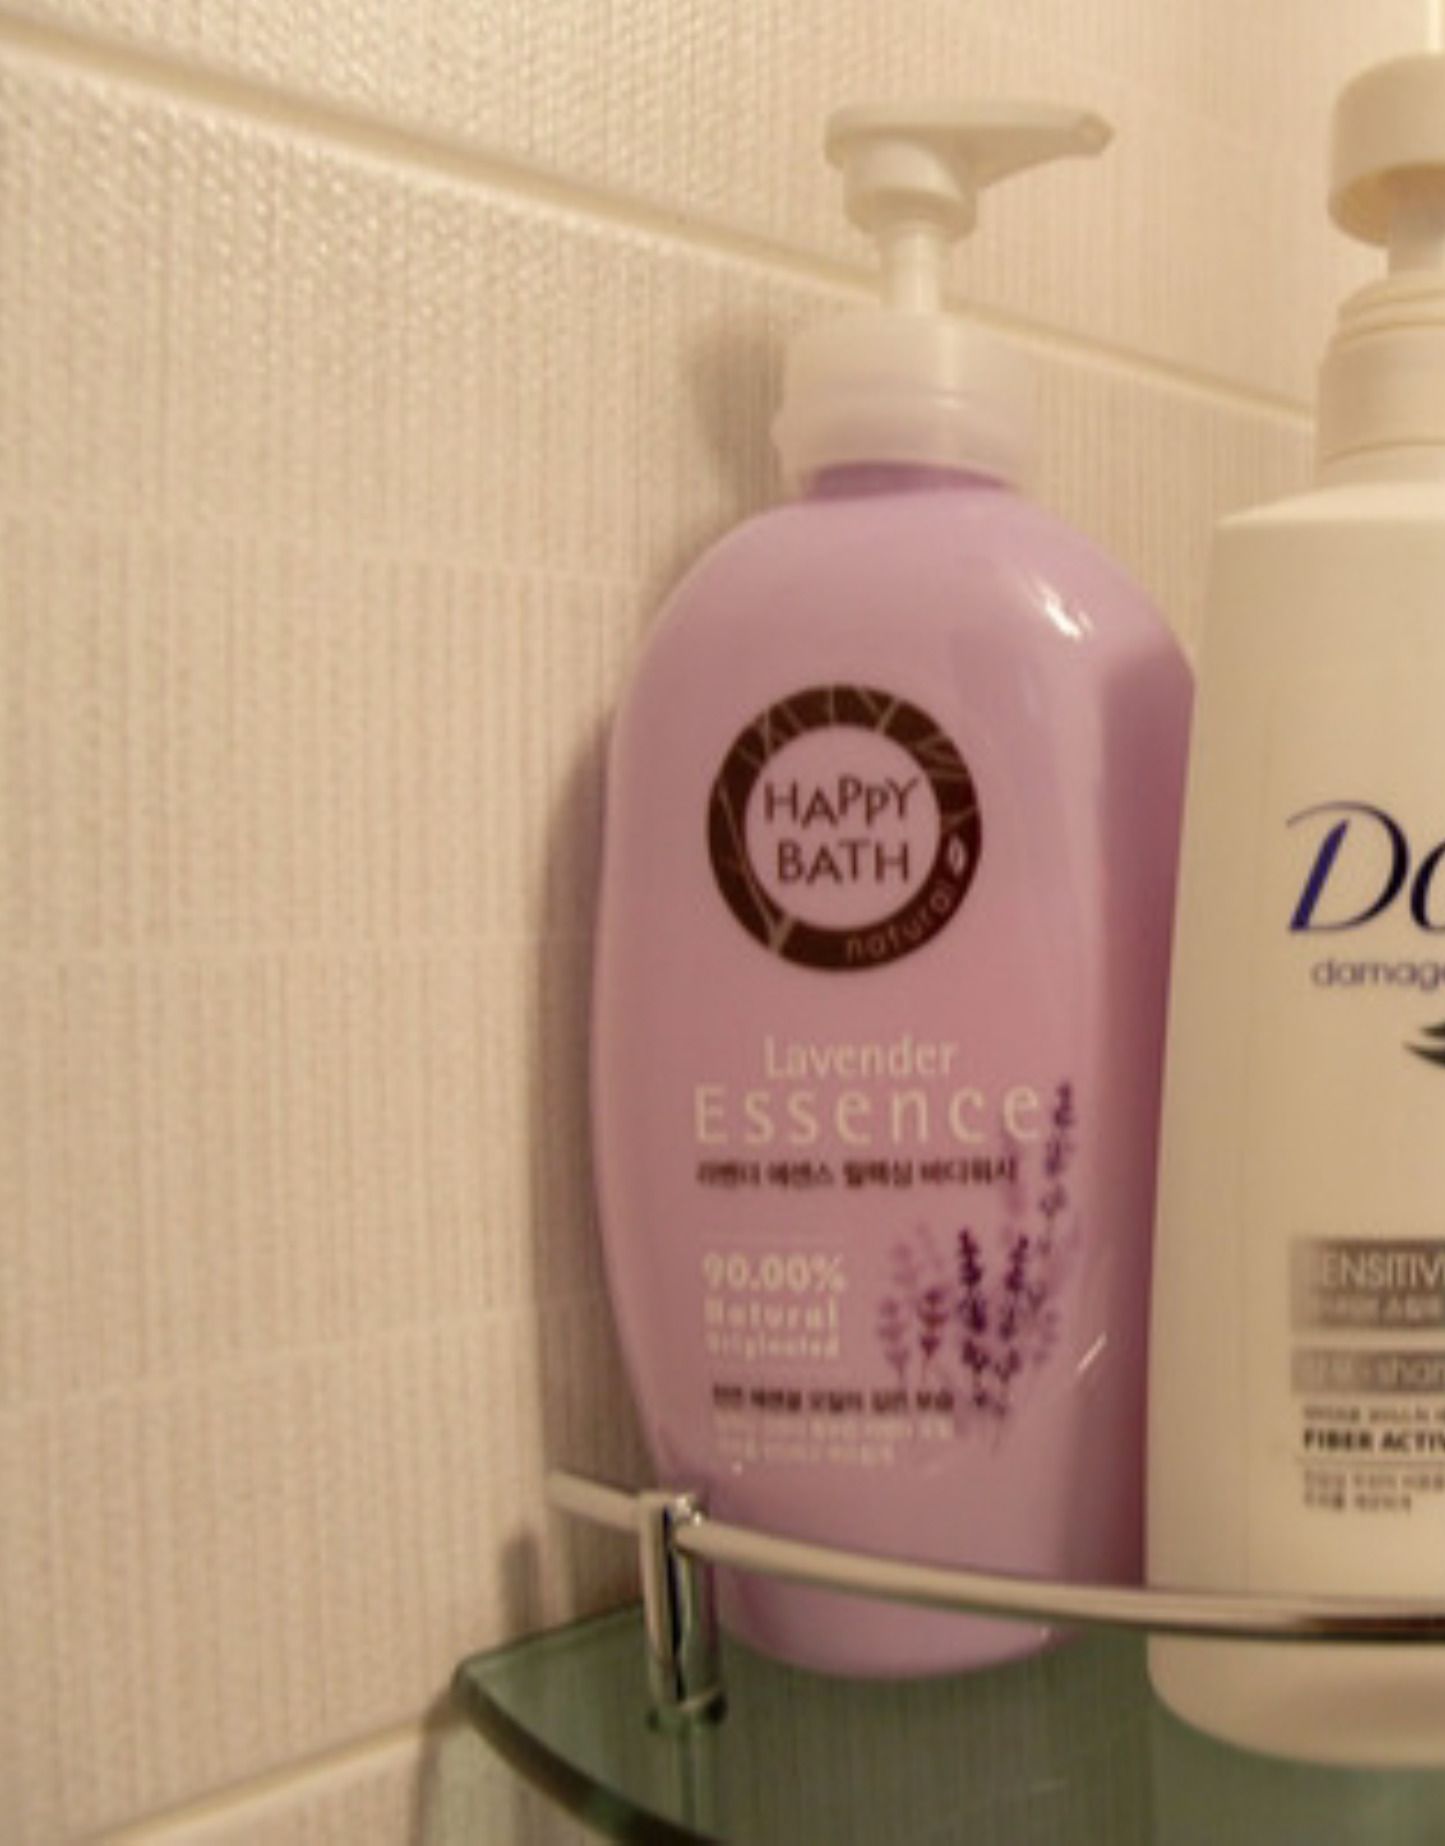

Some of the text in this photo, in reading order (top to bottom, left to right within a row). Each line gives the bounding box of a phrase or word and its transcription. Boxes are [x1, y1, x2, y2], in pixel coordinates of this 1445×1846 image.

[764, 773, 918, 829] HAPPY
[777, 836, 909, 885] BATH
[845, 881, 962, 963] natural
[764, 1034, 958, 1079] Lavender
[694, 1083, 1039, 1145] Essence
[703, 1252, 845, 1292] 90.00%
[704, 1297, 839, 1330] Natural
[1304, 1427, 1373, 1453] FIBER
